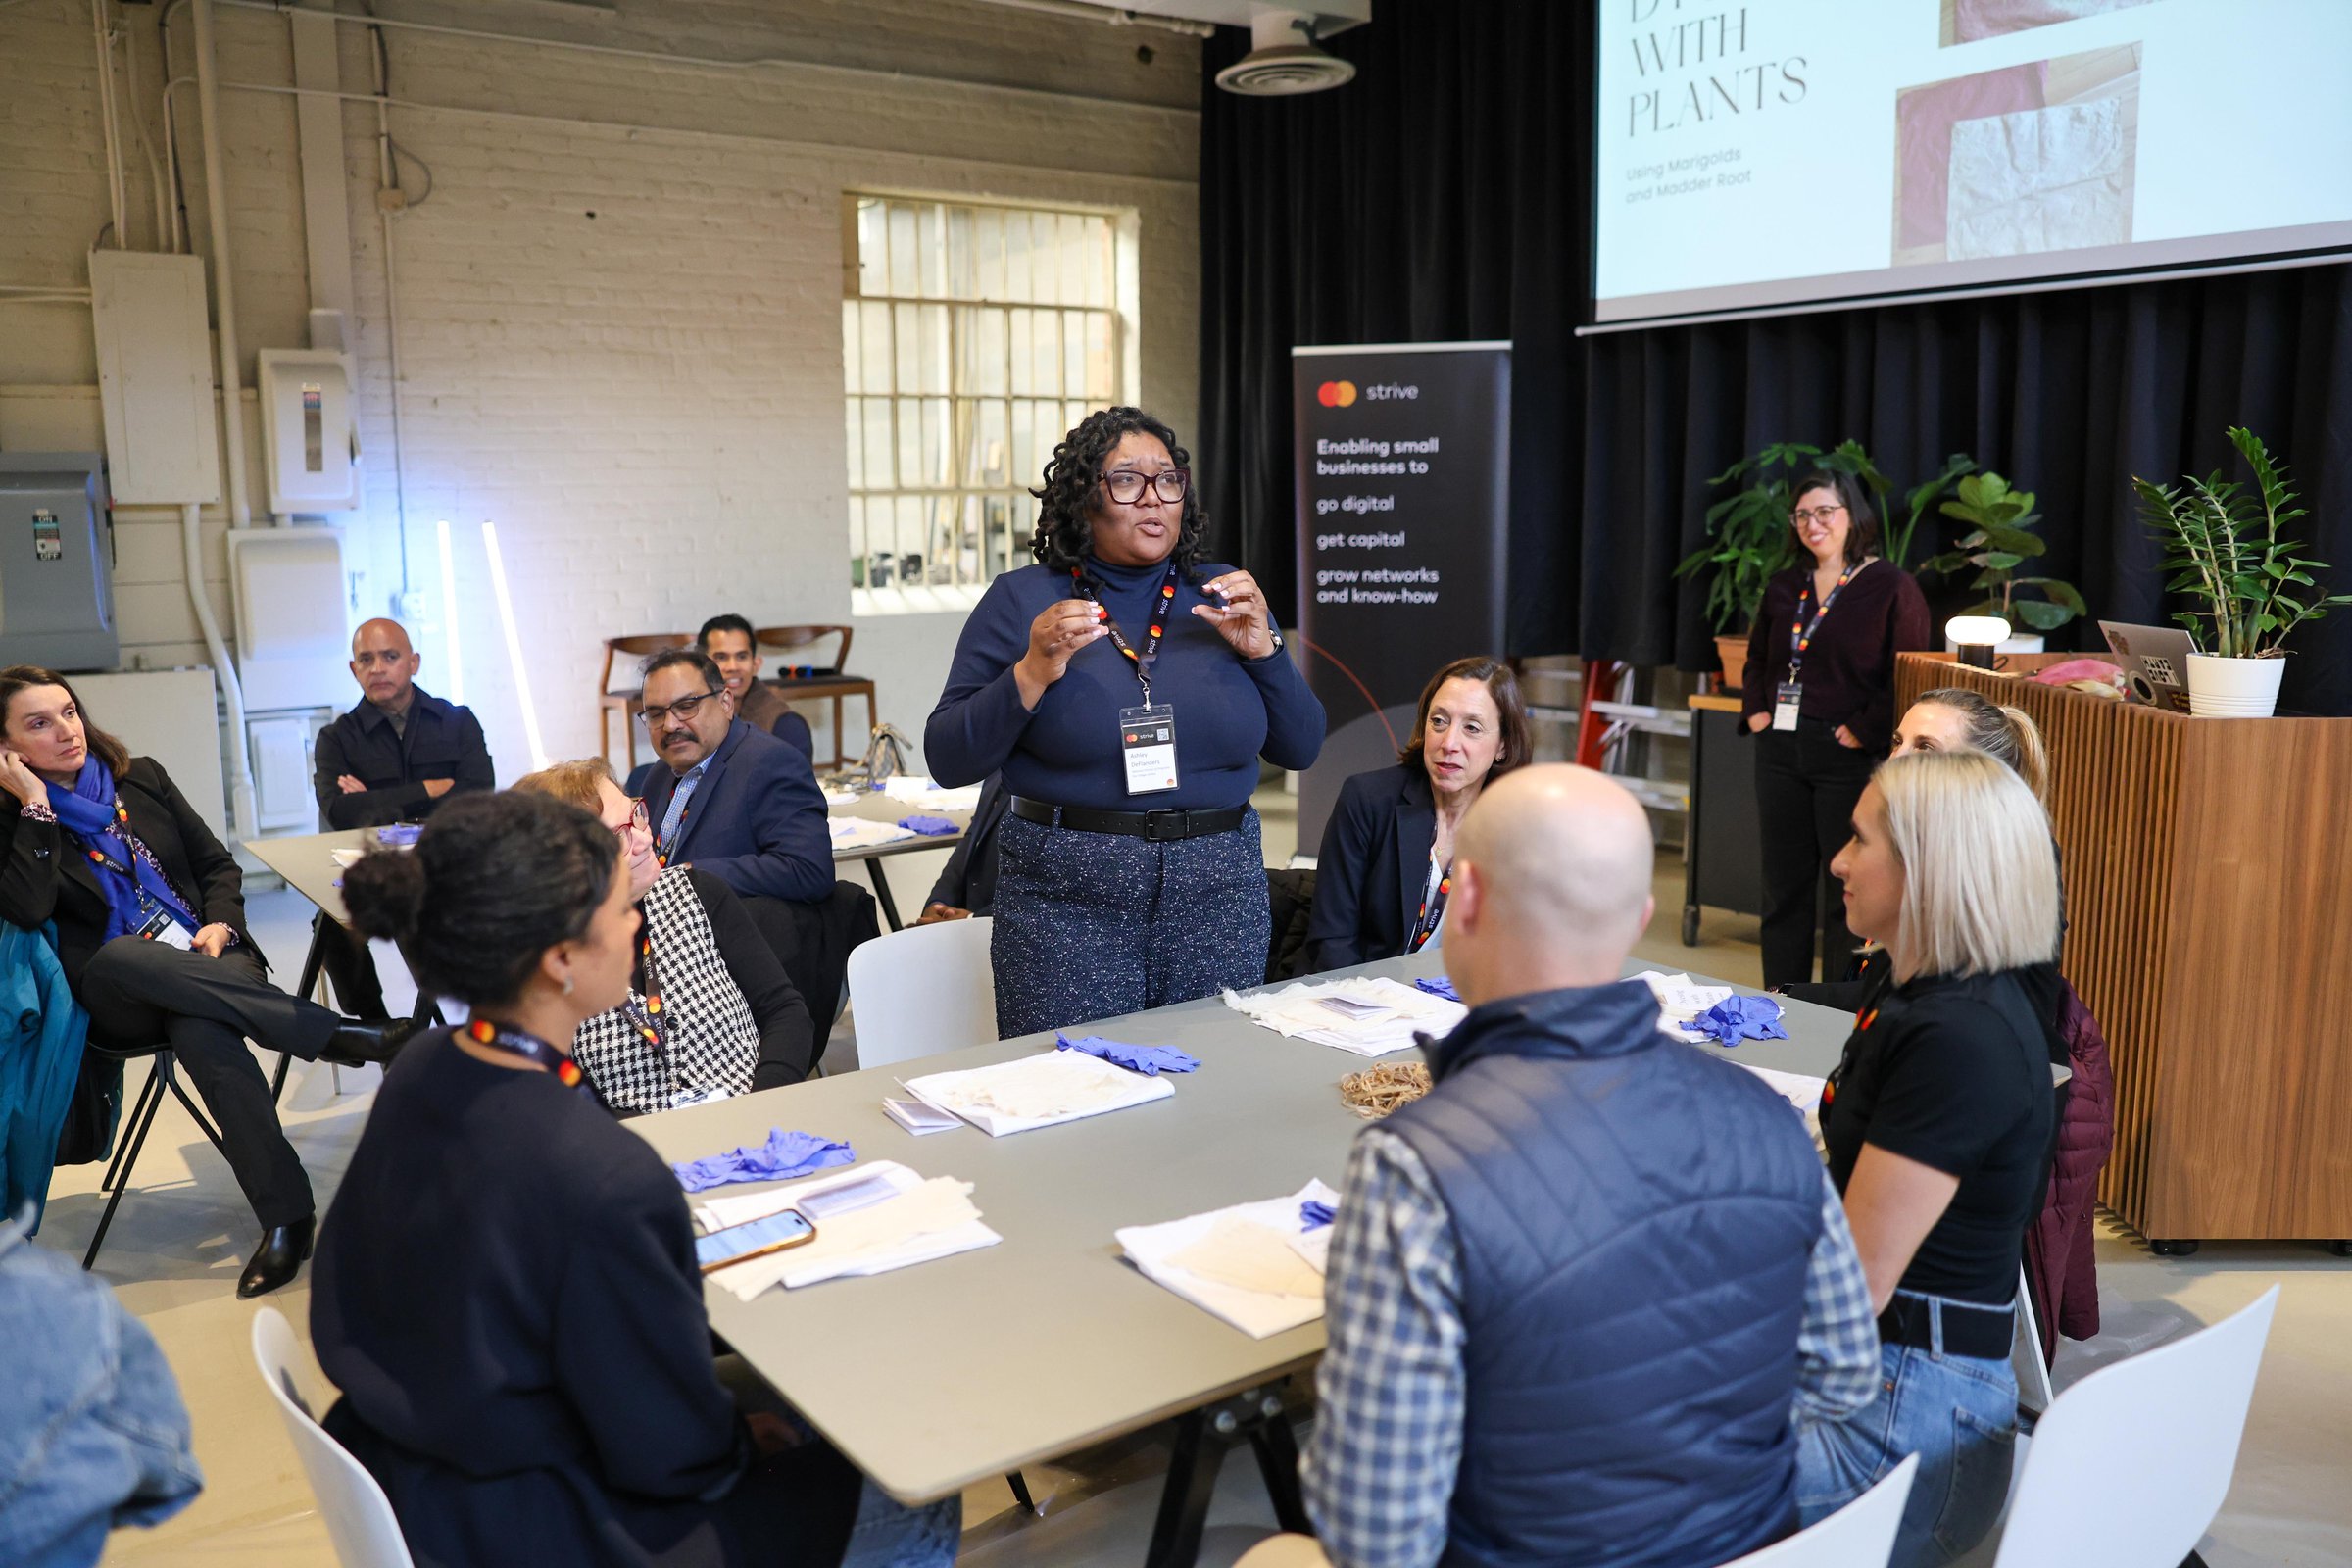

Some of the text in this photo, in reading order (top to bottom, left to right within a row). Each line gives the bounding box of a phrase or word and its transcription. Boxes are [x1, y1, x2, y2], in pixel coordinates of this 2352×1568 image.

[1632, 8, 1747, 77] WITH
[1630, 56, 1807, 138] PLANTS
[1626, 148, 1742, 182] Using Marigolds
[1625, 170, 1752, 204] and Madder Root
[1366, 381, 1419, 401] strive
[1316, 437, 1440, 458] Enabling small
[1316, 459, 1429, 475] businesses to
[1316, 495, 1395, 514] go digital
[1316, 530, 1405, 551] get capital
[1316, 566, 1440, 586] grow networks
[1316, 587, 1439, 604] and know-how
[1159, 598, 1169, 615] strive
[1111, 630, 1127, 647] strive
[1148, 638, 1157, 655] strive
[105, 859, 125, 874] strive
[1428, 908, 1440, 929] strive
[645, 956, 654, 981] strive
[625, 1005, 644, 1027] strive
[654, 1016, 665, 1043] strive
